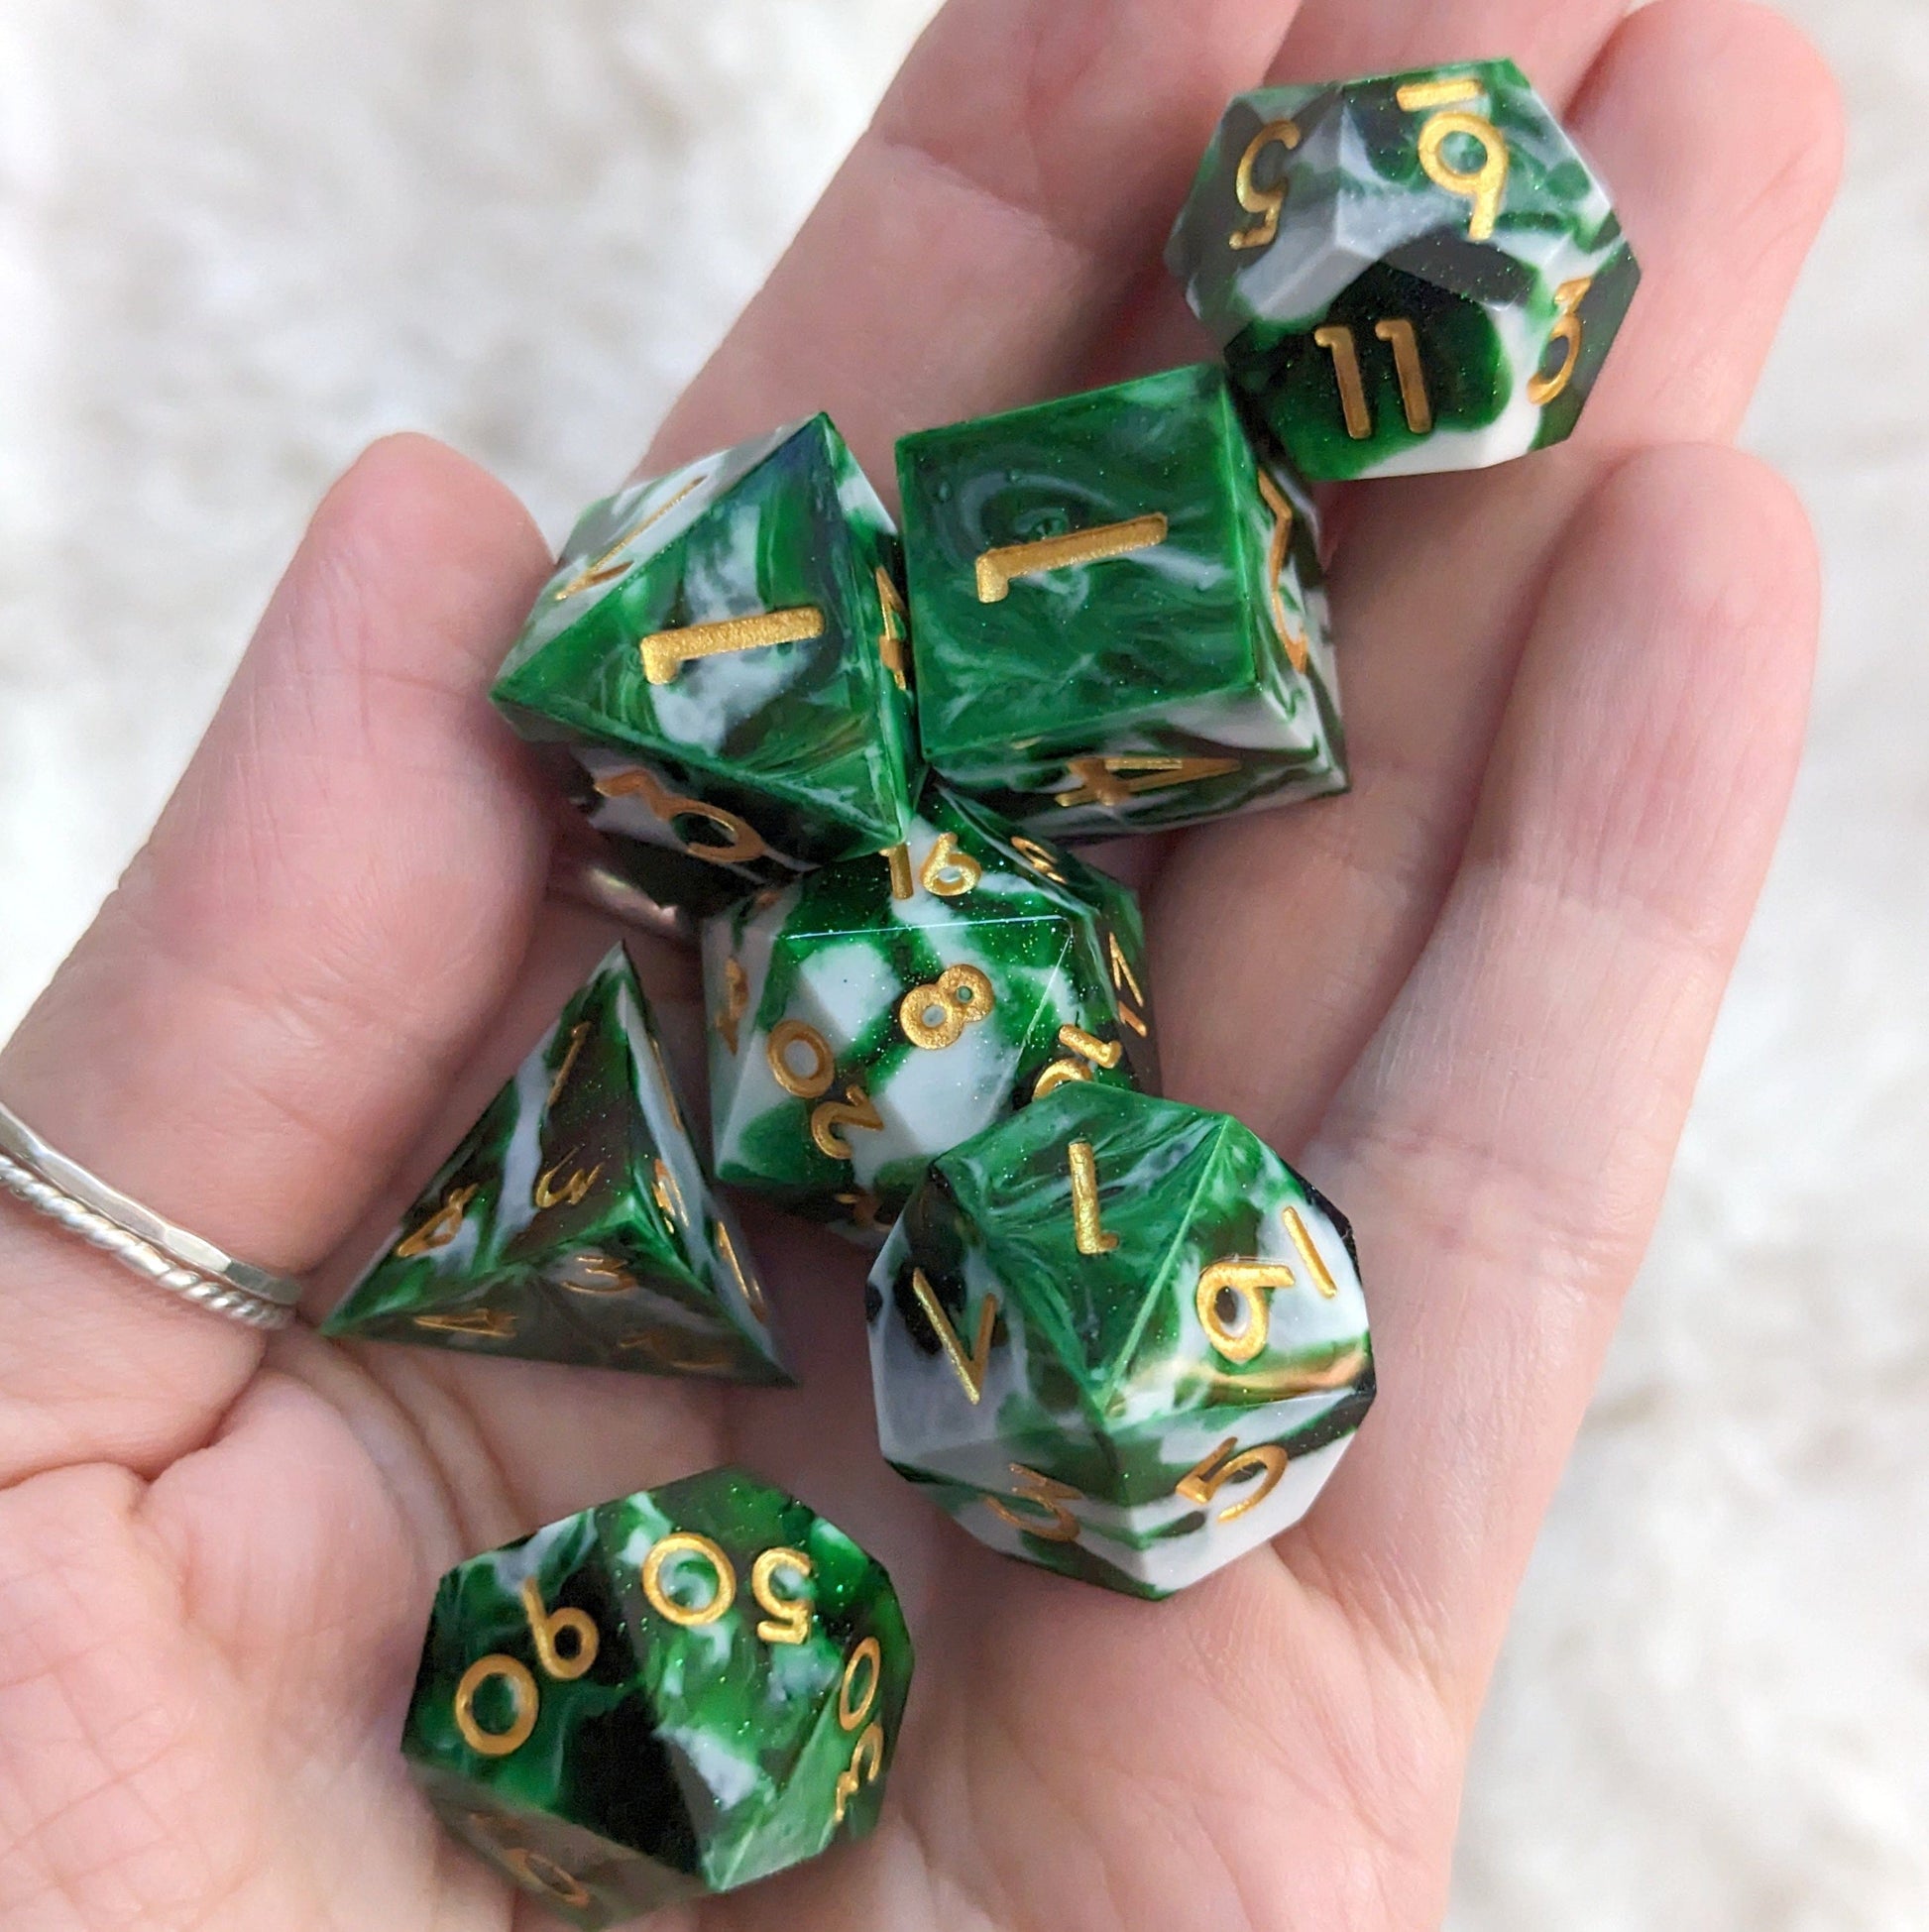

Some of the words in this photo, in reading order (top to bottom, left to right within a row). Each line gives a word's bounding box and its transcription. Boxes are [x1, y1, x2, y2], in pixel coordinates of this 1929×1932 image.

[1228, 120, 1301, 250] 5
[1314, 319, 1431, 439] 11
[975, 511, 1168, 604] 1
[640, 605, 826, 685] 1
[1054, 755, 1243, 807] 4
[879, 832, 982, 900] 16
[899, 963, 995, 1050] 8
[767, 1019, 885, 1161] 20
[1069, 1138, 1120, 1255] 1
[912, 1267, 999, 1406] 7
[981, 1462, 1083, 1542] 3
[1176, 1435, 1288, 1523] 5
[641, 1532, 815, 1646] 50
